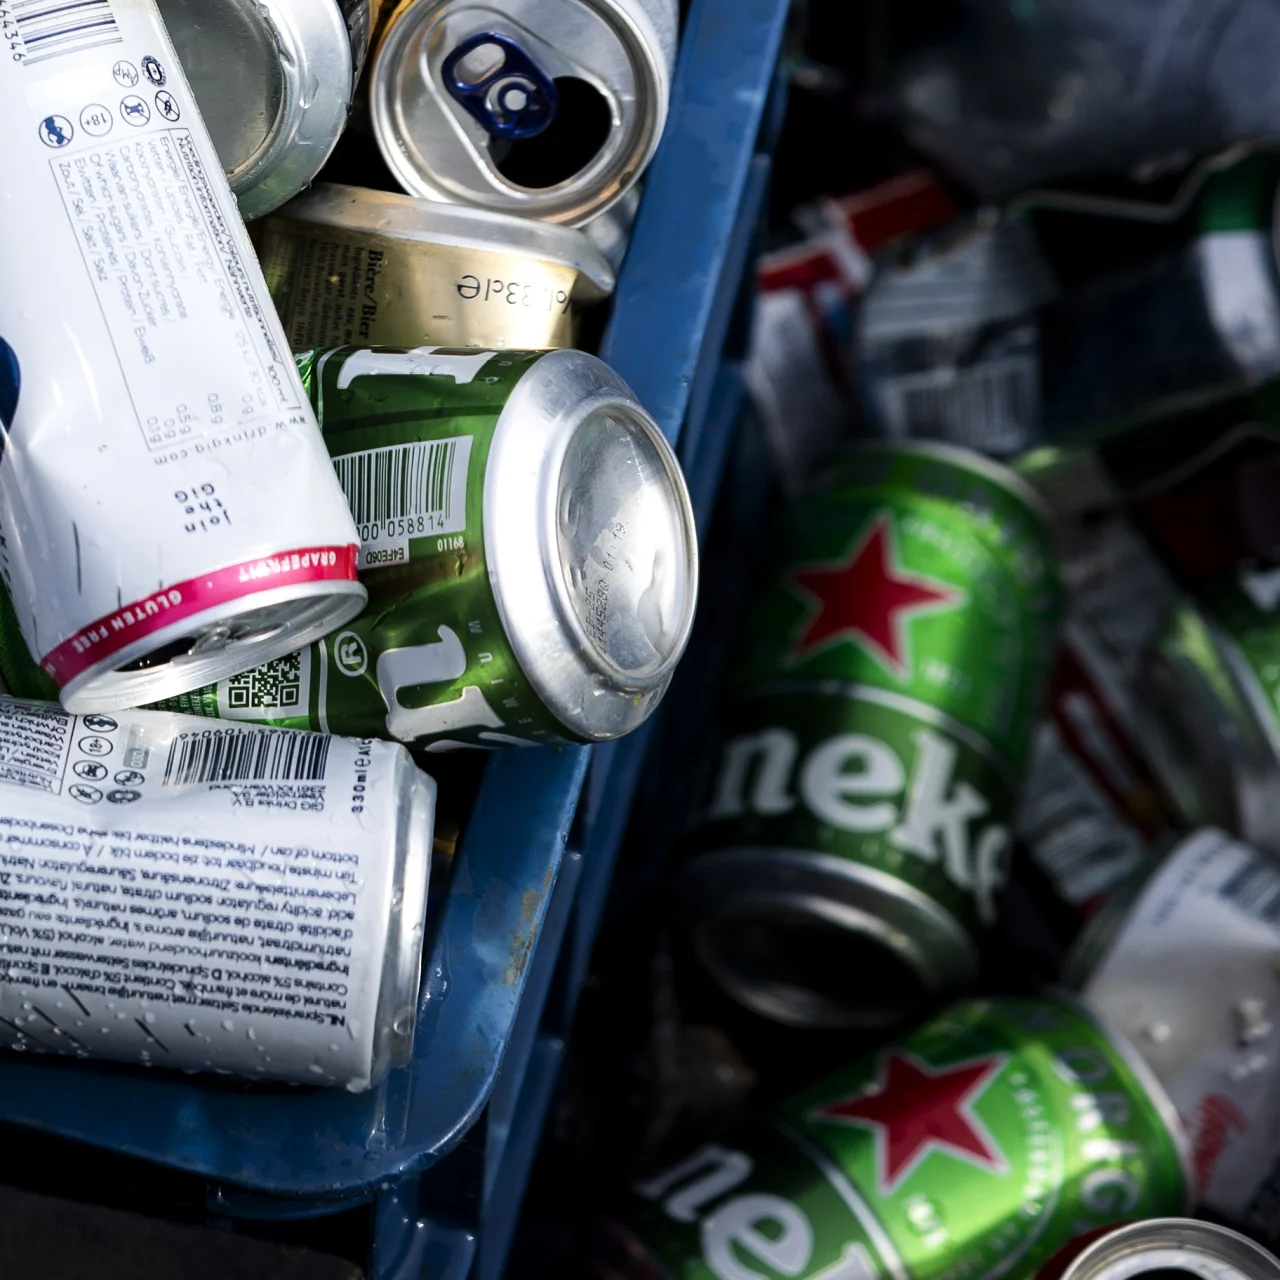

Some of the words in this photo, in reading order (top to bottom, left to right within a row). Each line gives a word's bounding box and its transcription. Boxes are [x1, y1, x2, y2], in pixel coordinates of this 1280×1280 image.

[358, 249, 383, 338] Bière/Bier
[183, 498, 222, 515] the
[183, 512, 232, 534] join
[386, 514, 445, 537] 058814
[365, 547, 404, 564] E4FE06D
[109, 590, 182, 631] GLUTEN
[71, 624, 107, 651] FREE
